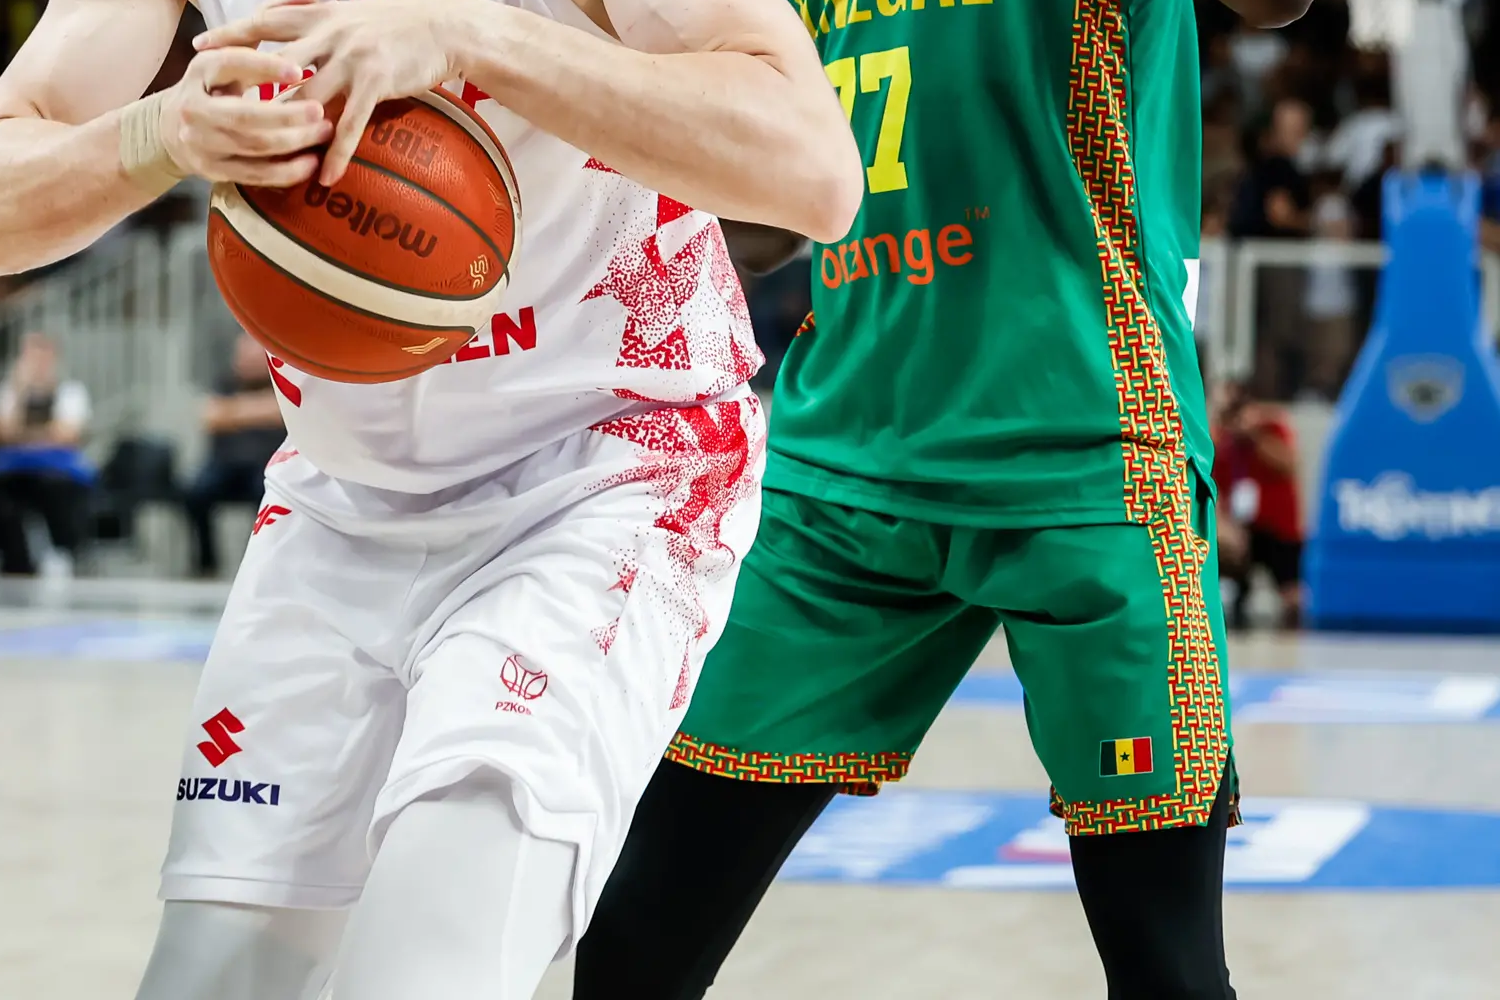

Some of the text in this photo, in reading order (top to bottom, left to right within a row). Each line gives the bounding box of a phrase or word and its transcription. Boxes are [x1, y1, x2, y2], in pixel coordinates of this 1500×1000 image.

[304, 180, 438, 258] molten
[821, 223, 974, 289] orange
[177, 778, 280, 806] SUZUKI
